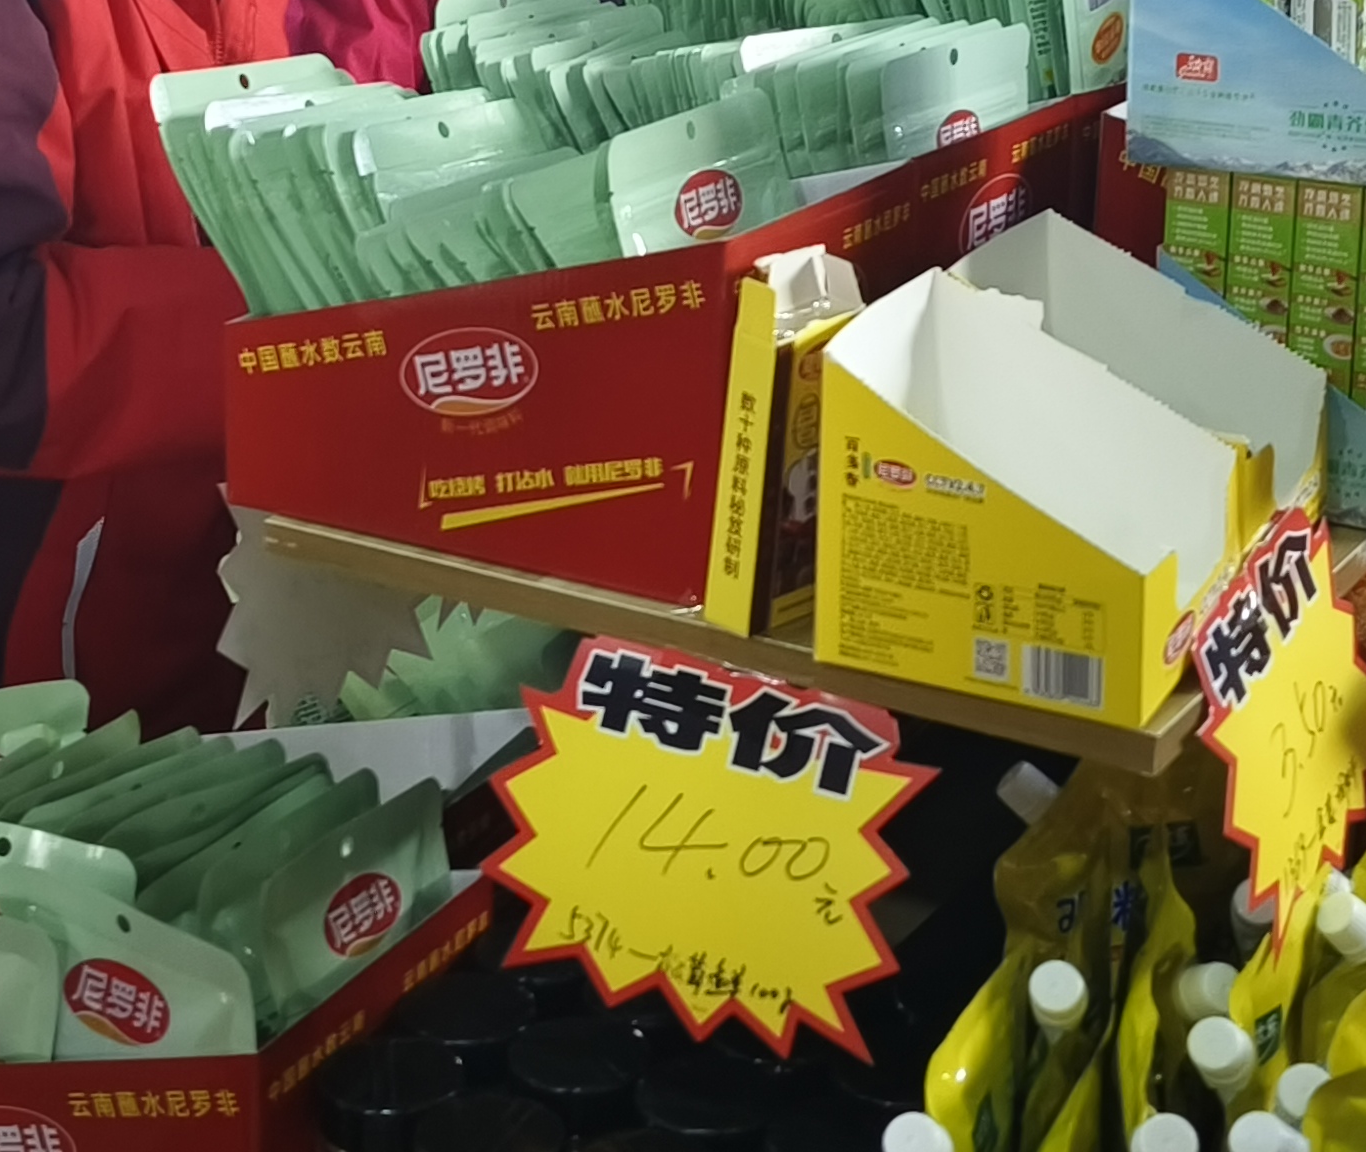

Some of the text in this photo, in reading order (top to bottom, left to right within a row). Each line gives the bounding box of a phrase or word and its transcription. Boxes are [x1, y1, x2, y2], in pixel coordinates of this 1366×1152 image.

[679, 175, 738, 234] 尼罗非
[530, 280, 707, 331] 云南蘸水尼罗非
[238, 329, 388, 375] 中国蘸水数云南
[412, 341, 527, 396] 尼罗非
[1202, 529, 1318, 711] 特价
[579, 651, 888, 799] 特价
[586, 783, 831, 880] 14.00
[327, 878, 398, 949] 尼罗非
[76, 963, 168, 1035] 尼罗非
[67, 1089, 241, 1120] 云南蘸水尼罗非
